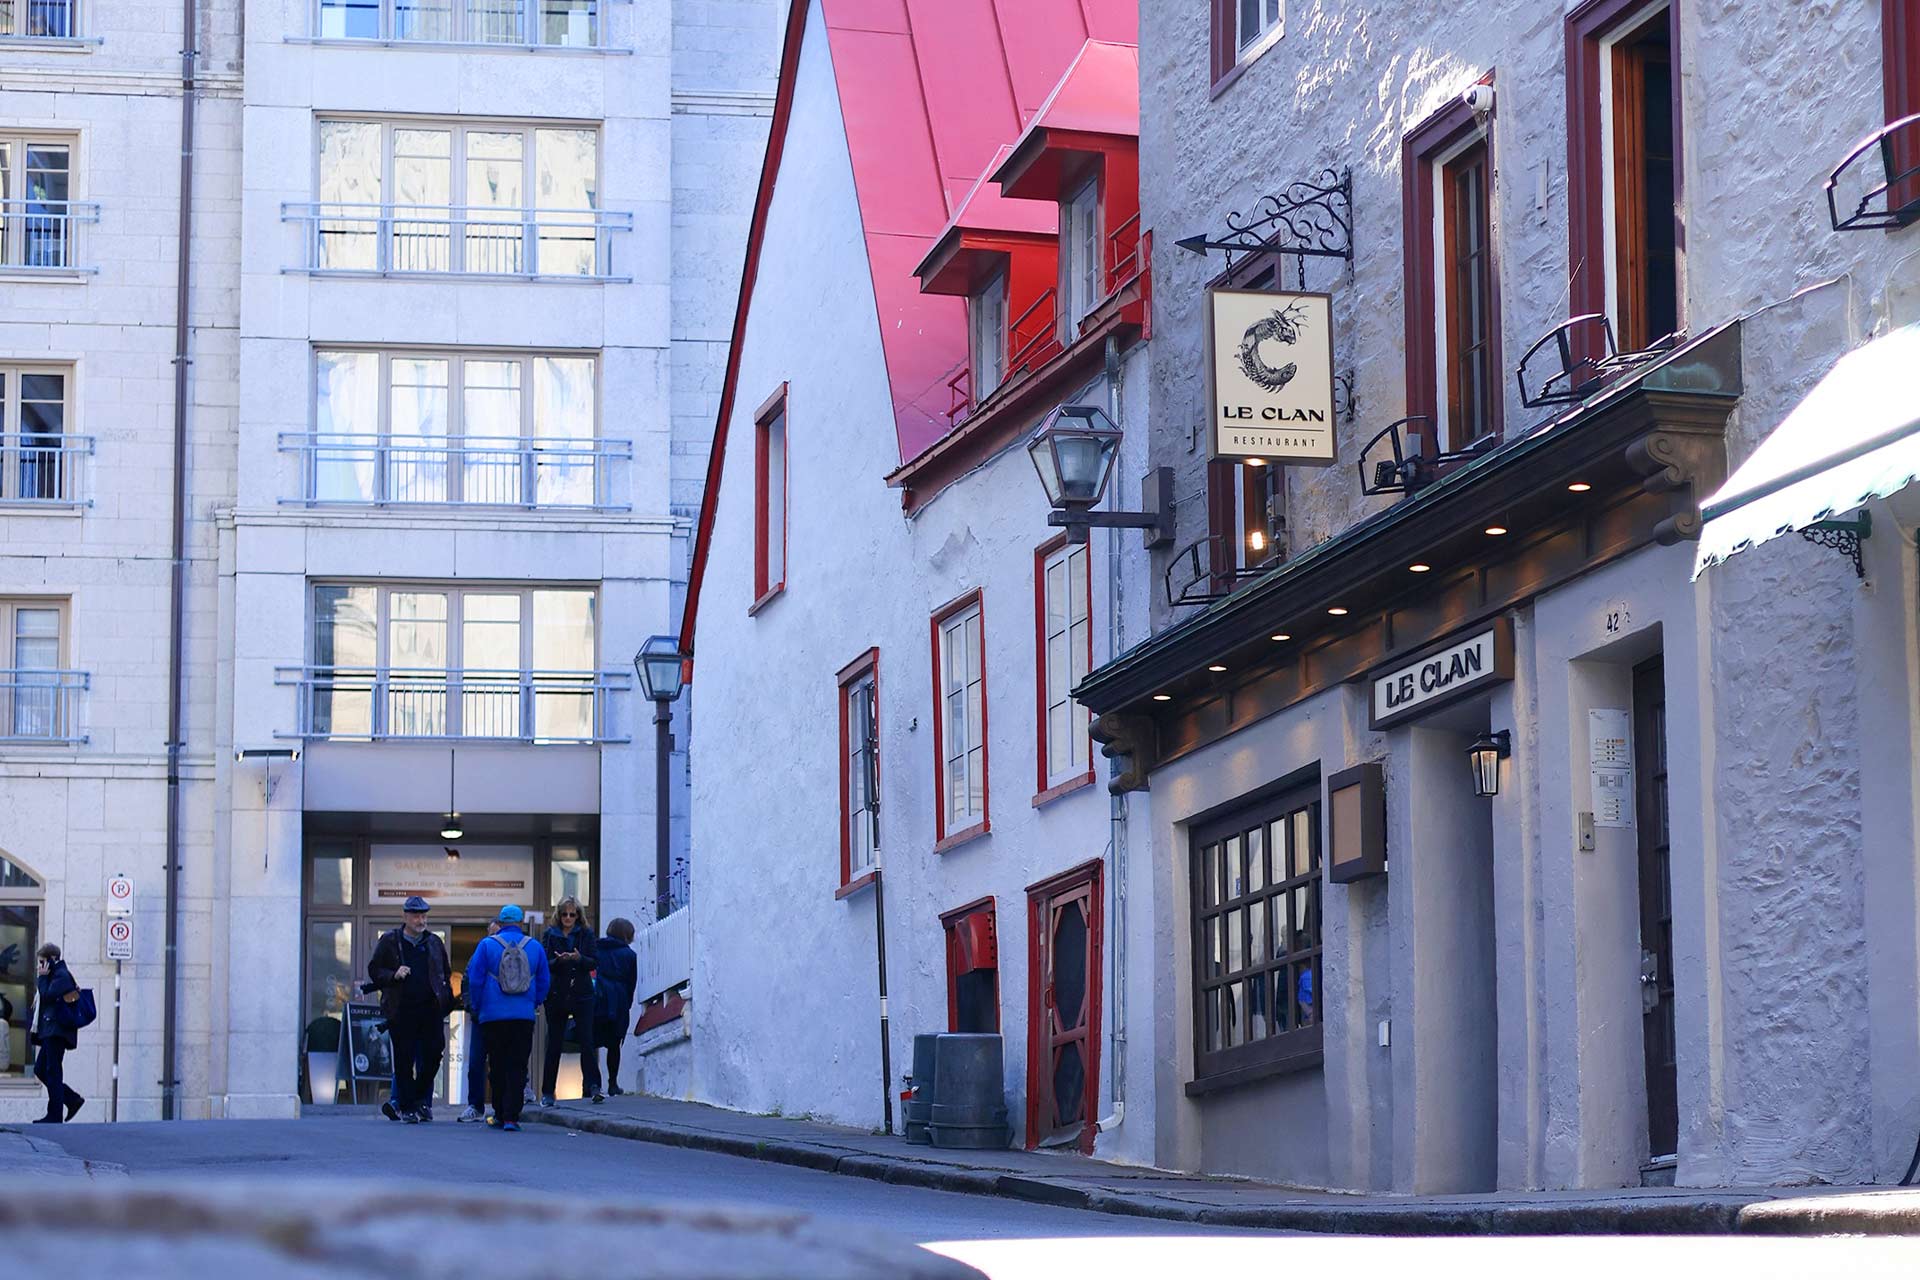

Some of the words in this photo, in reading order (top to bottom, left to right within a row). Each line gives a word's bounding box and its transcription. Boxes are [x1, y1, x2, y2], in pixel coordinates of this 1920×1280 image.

[1223, 406, 1253, 419] LE
[1261, 407, 1325, 422] CLAN
[1233, 436, 1317, 447] RESTAURANT
[1606, 612, 1620, 633] 42
[1386, 673, 1414, 708] LE
[1420, 643, 1482, 693] CLAN
